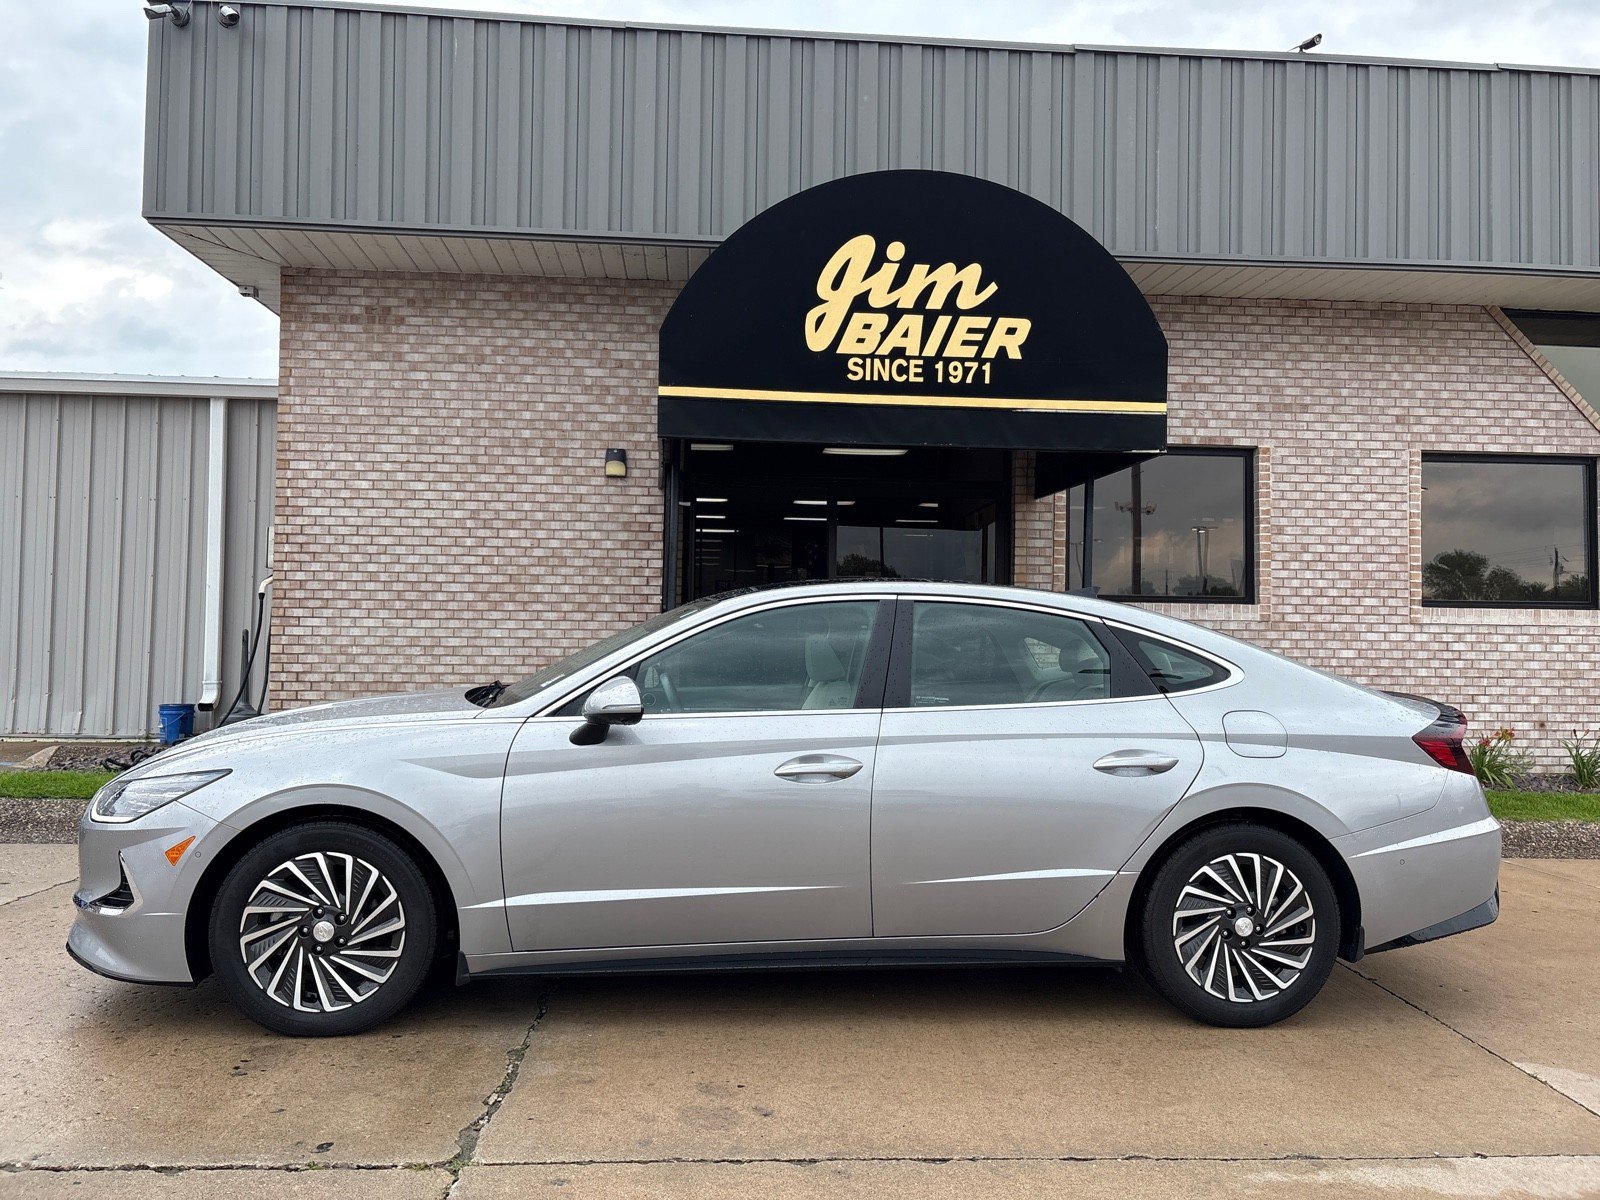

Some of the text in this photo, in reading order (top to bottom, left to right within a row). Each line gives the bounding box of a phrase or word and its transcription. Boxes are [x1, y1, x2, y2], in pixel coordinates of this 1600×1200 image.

[805, 234, 999, 352] Jim
[836, 312, 1032, 360] BAIER
[847, 357, 991, 384] SINCE 1971
